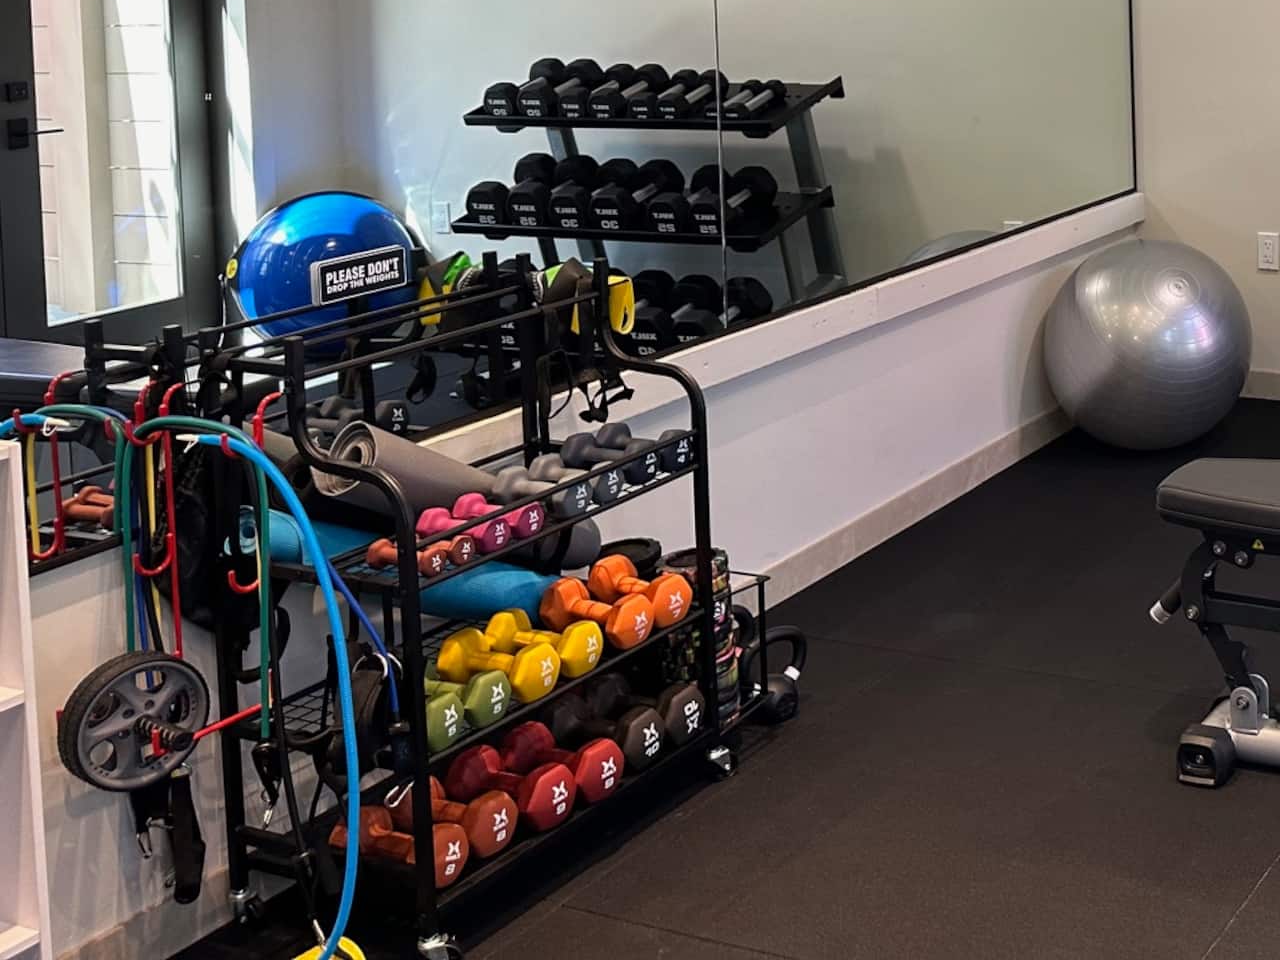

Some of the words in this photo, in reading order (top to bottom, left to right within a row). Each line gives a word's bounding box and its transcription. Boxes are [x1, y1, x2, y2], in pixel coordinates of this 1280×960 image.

[325, 264, 365, 286] PLEASE
[367, 257, 399, 276] DON'T
[326, 283, 348, 295] DROP
[349, 278, 364, 289] THE
[365, 270, 400, 285] WEIGHTS
